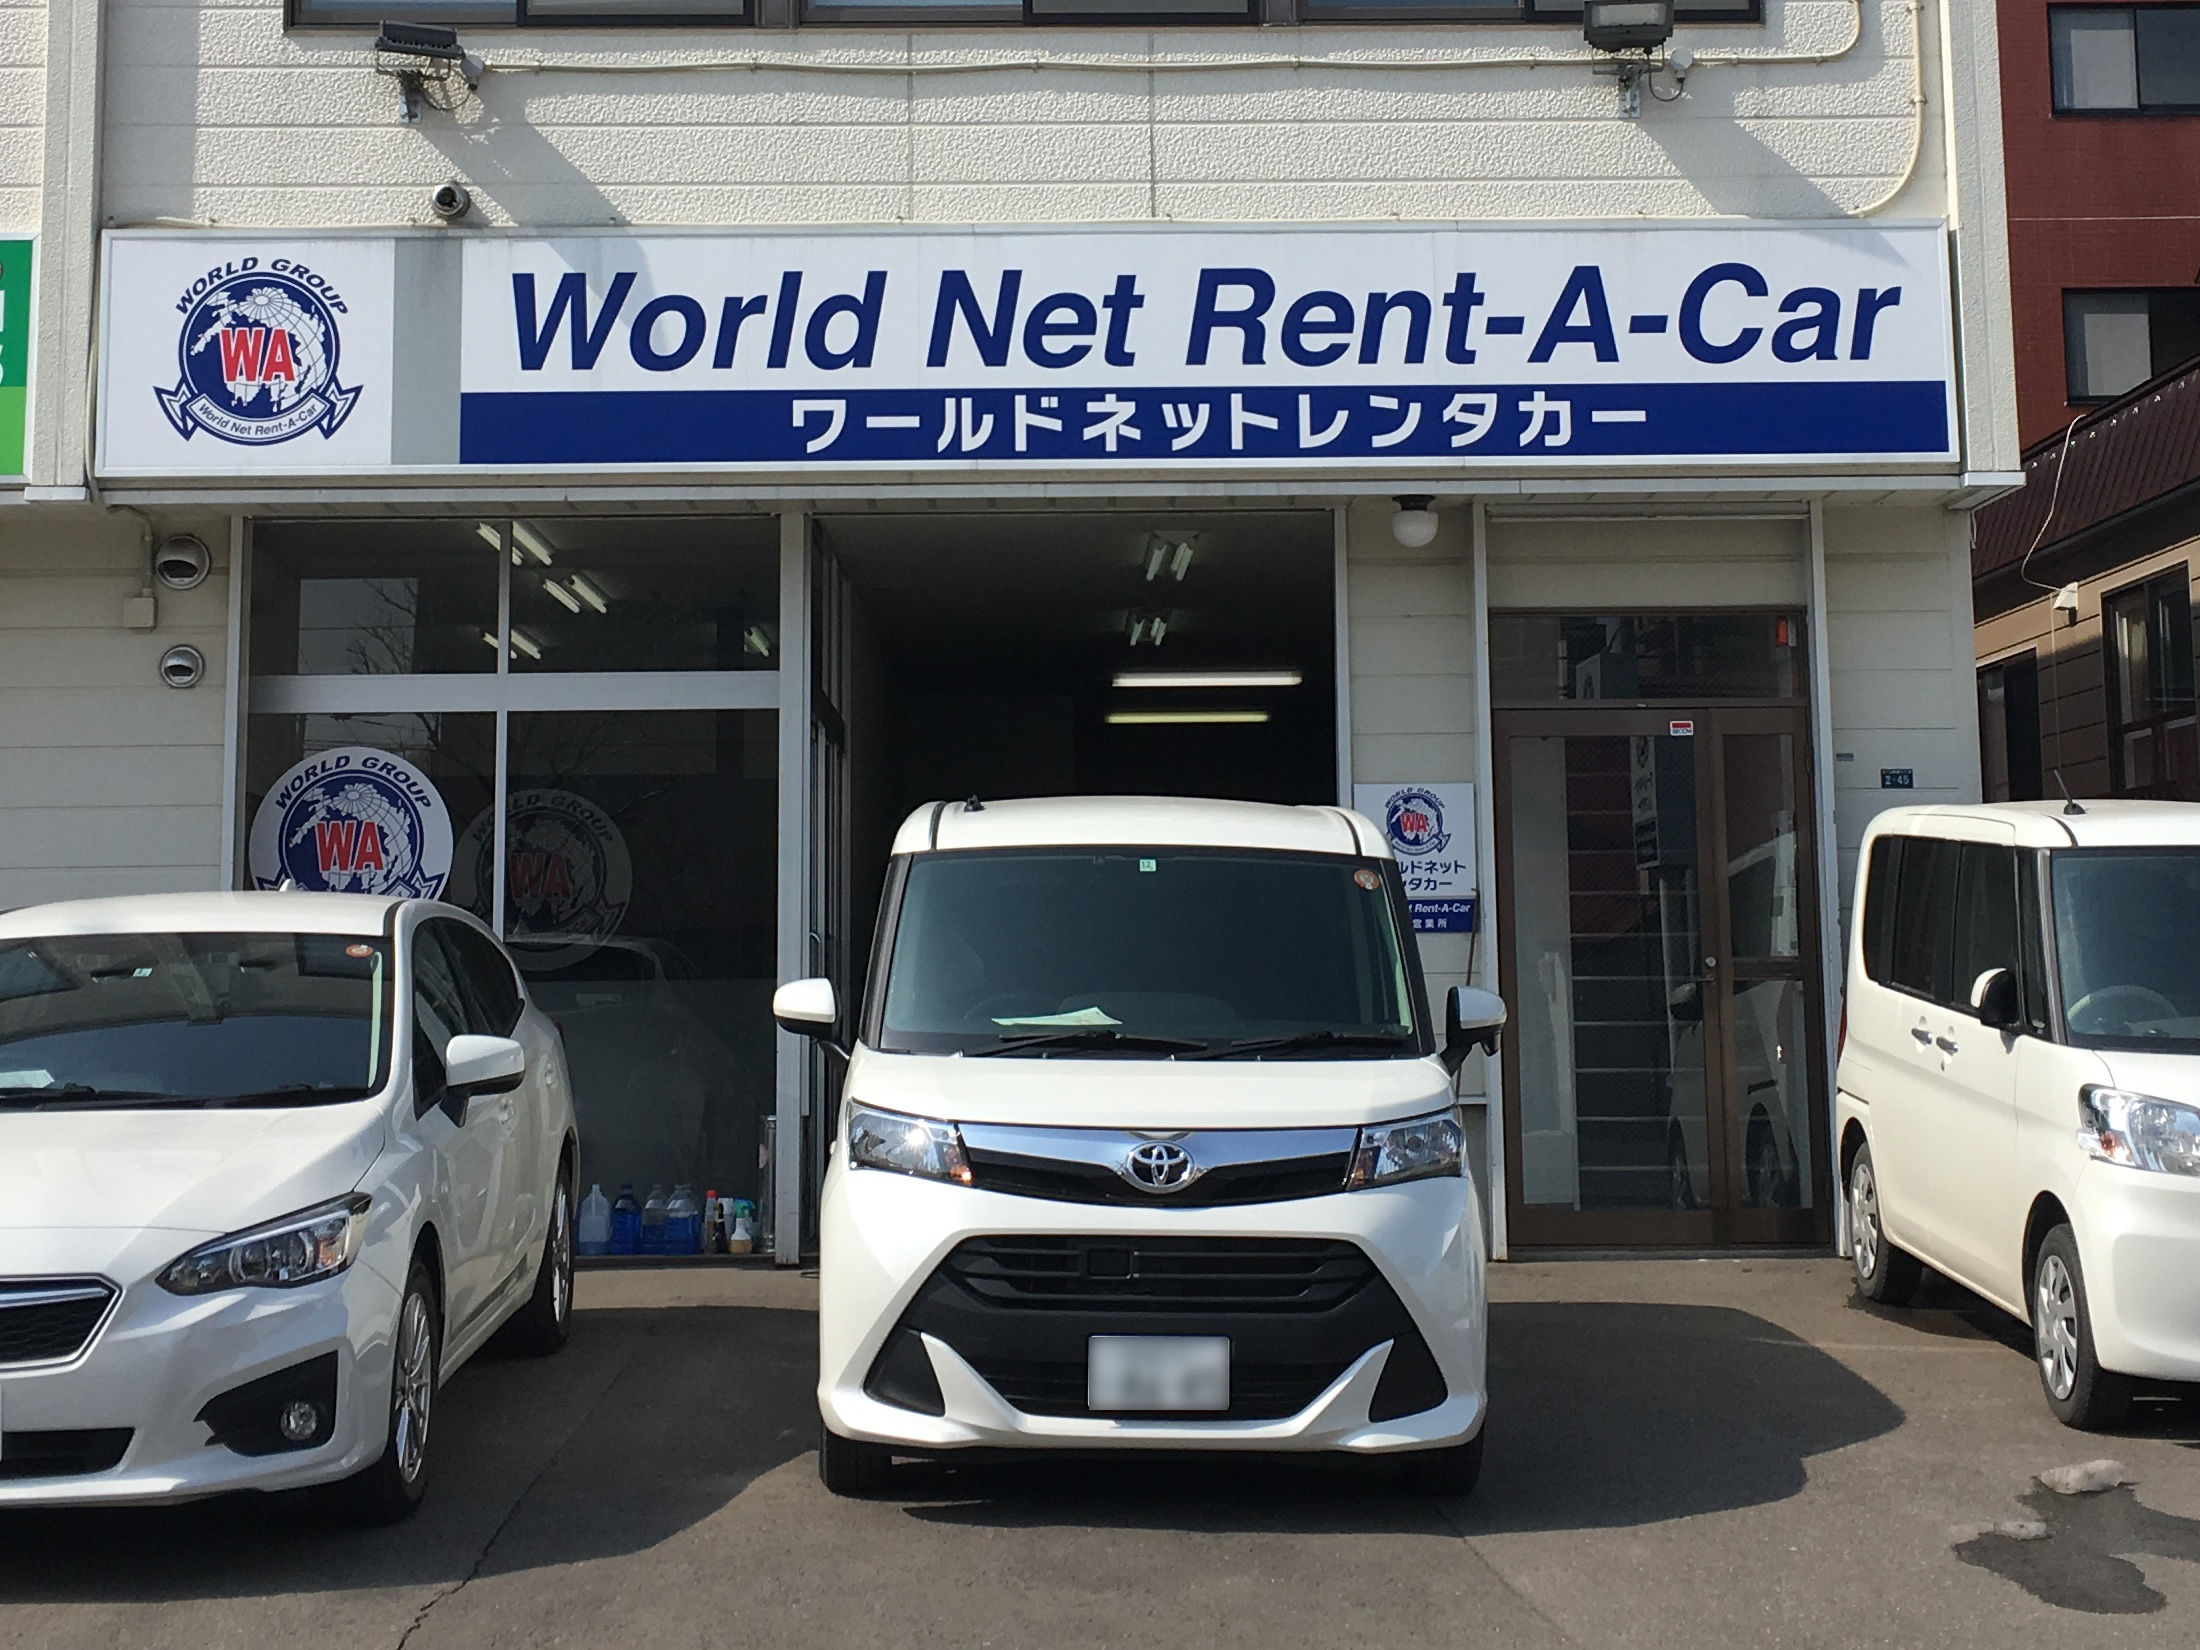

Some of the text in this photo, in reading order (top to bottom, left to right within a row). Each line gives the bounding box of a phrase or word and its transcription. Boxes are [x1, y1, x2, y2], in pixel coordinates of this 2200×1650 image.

[175, 257, 349, 315] WORLD GROUP
[512, 262, 1902, 371] World Net Rent-A-Car
[219, 327, 296, 383] WA
[199, 403, 317, 436] World Net Rent-A-Car
[792, 391, 1648, 454] ワールドネットレンタカー
[275, 755, 432, 810] WORLD GROUP
[1385, 787, 1413, 808] WORLD
[315, 820, 384, 872] WA
[1401, 812, 1427, 832] WA
[508, 853, 571, 899] WA
[1414, 902, 1471, 913] Rent-A-Car
